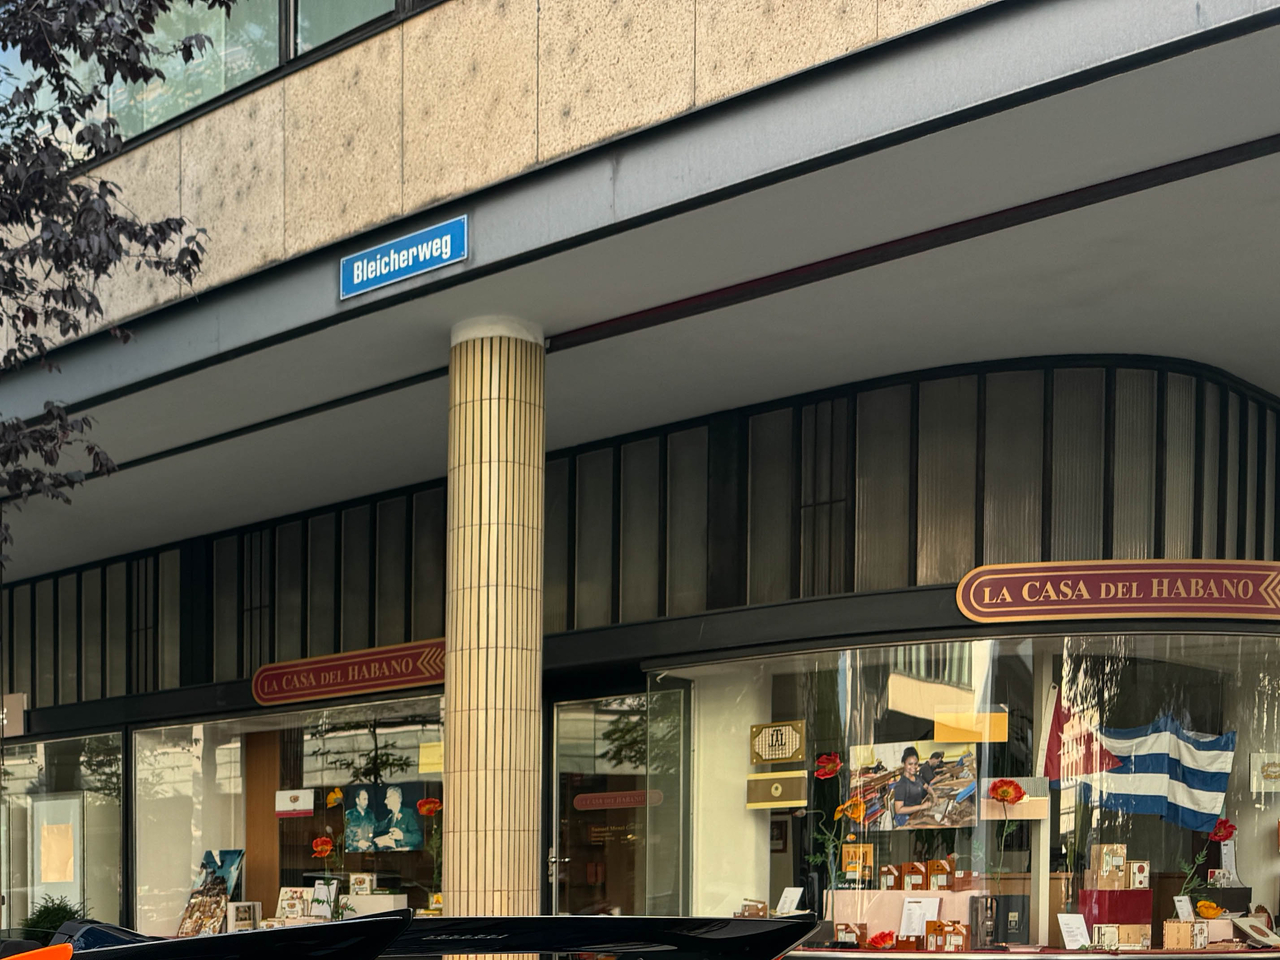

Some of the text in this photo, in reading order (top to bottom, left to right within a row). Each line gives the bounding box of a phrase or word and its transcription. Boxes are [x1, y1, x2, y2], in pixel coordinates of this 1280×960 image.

[353, 234, 452, 285] Bleicherweg
[982, 578, 1254, 604] LA CASA DEL HABANO
[264, 657, 413, 693] LA CASA DEL HABANO
